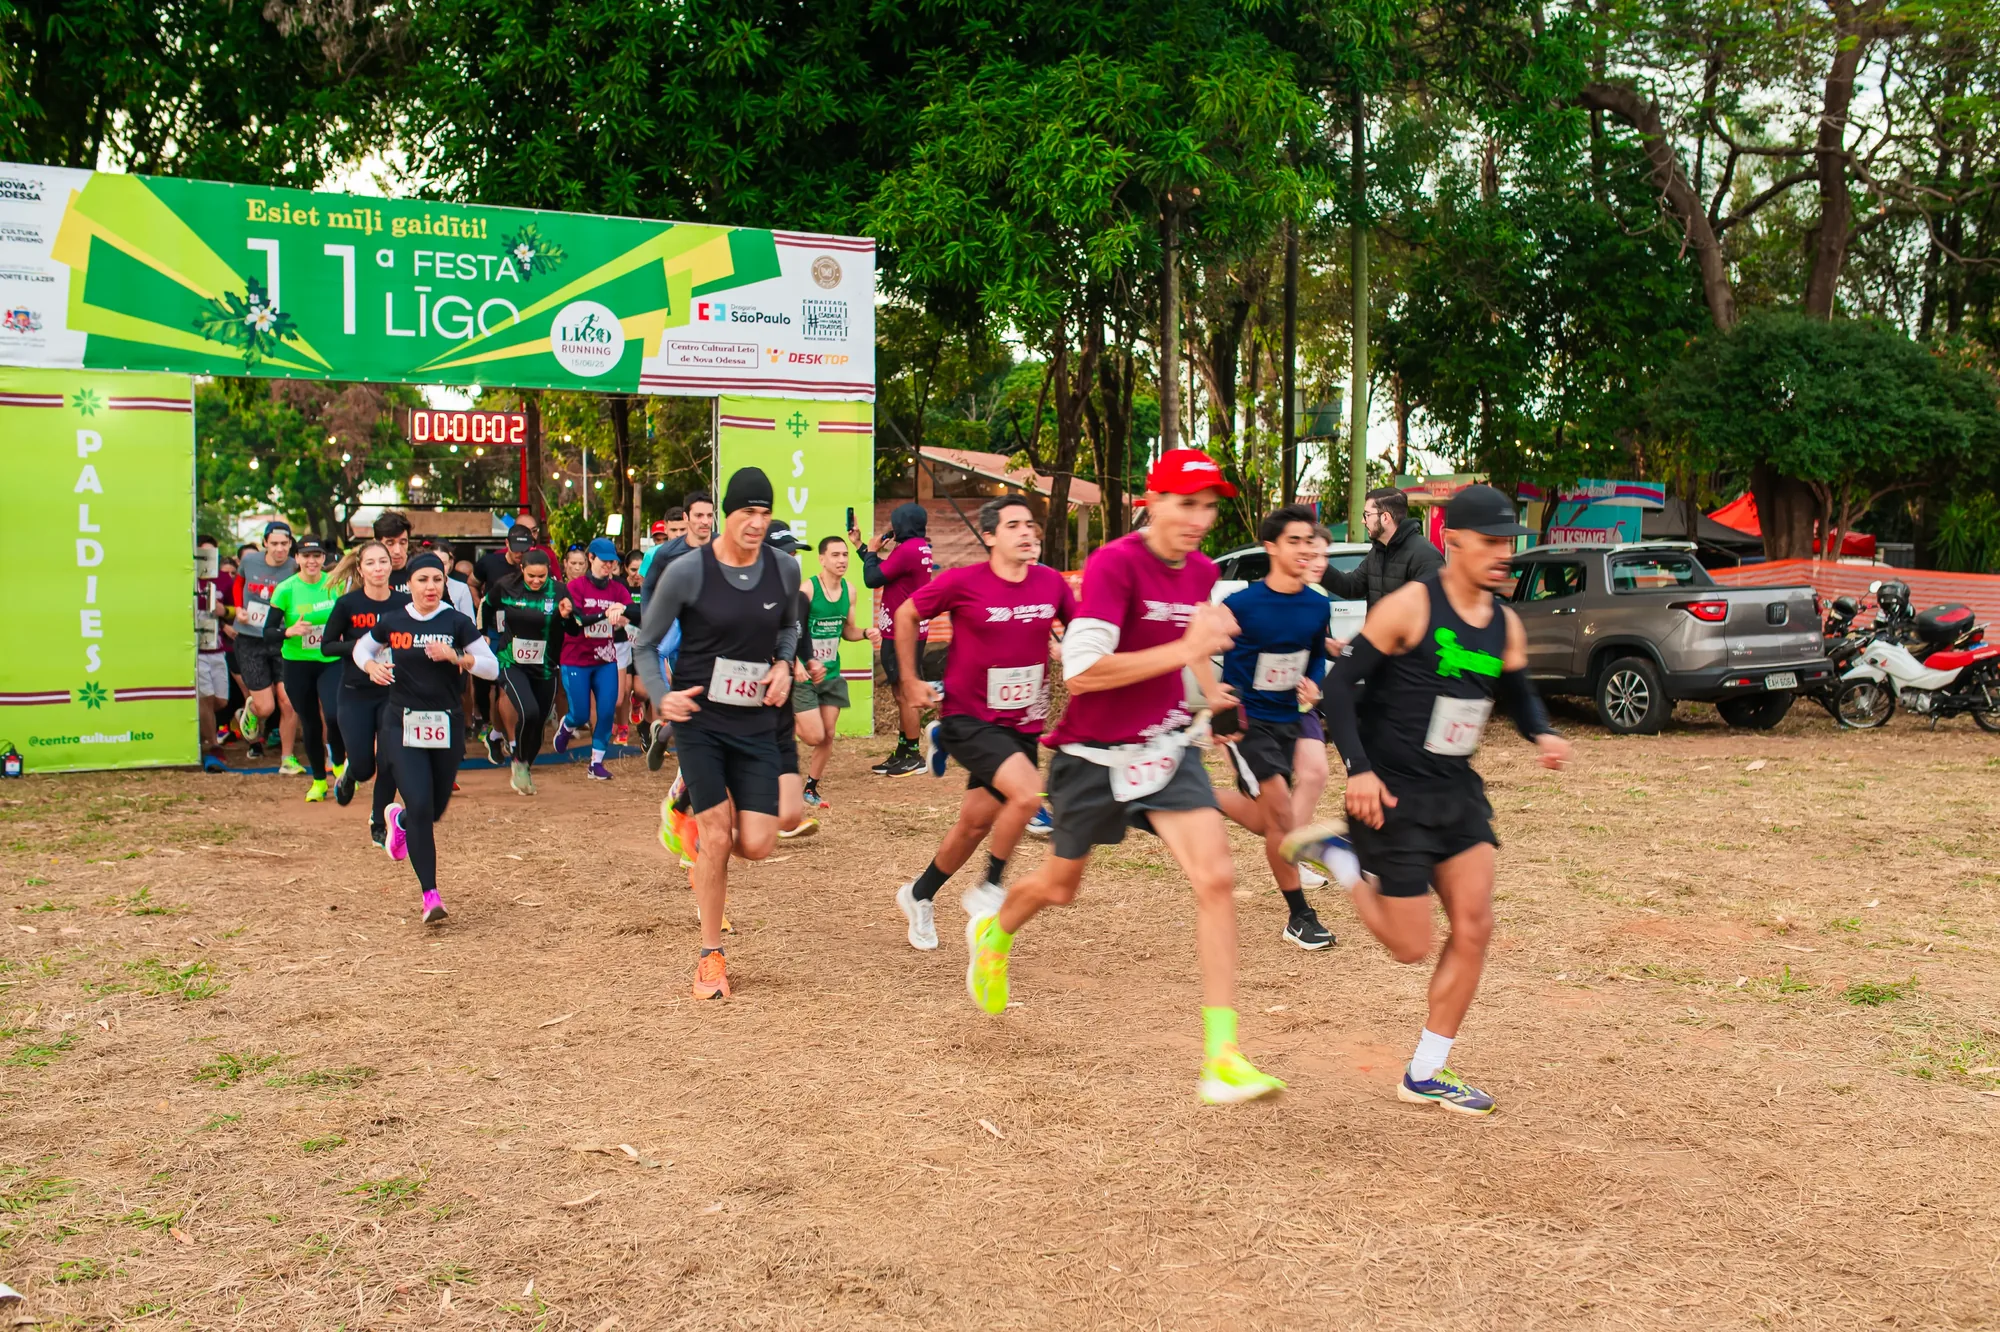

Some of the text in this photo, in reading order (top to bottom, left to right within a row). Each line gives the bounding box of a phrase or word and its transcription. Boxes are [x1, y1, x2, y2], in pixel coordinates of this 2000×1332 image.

[246, 199, 488, 239] Esiet mīļi gaidīti!
[414, 250, 520, 283] FESTA
[386, 286, 521, 339] LĪGO
[561, 344, 611, 356] RUNNING
[671, 342, 755, 354] Centro Cultural Leto
[680, 355, 746, 365] de Nova Odessa
[788, 352, 849, 365] DESKTOP
[414, 412, 524, 443] 00:00:02
[1550, 529, 1606, 545] MILKSHAKE
[74, 429, 104, 673] PALDIES
[251, 613, 266, 622] 07
[351, 613, 376, 628] 100
[590, 623, 608, 633] 070
[390, 632, 454, 649] 100 LIMITES
[517, 649, 539, 660] 057
[724, 677, 759, 698] 148
[1000, 683, 1033, 702] 023
[28, 730, 155, 747] @centroculturalleto
[413, 726, 446, 741] 136
